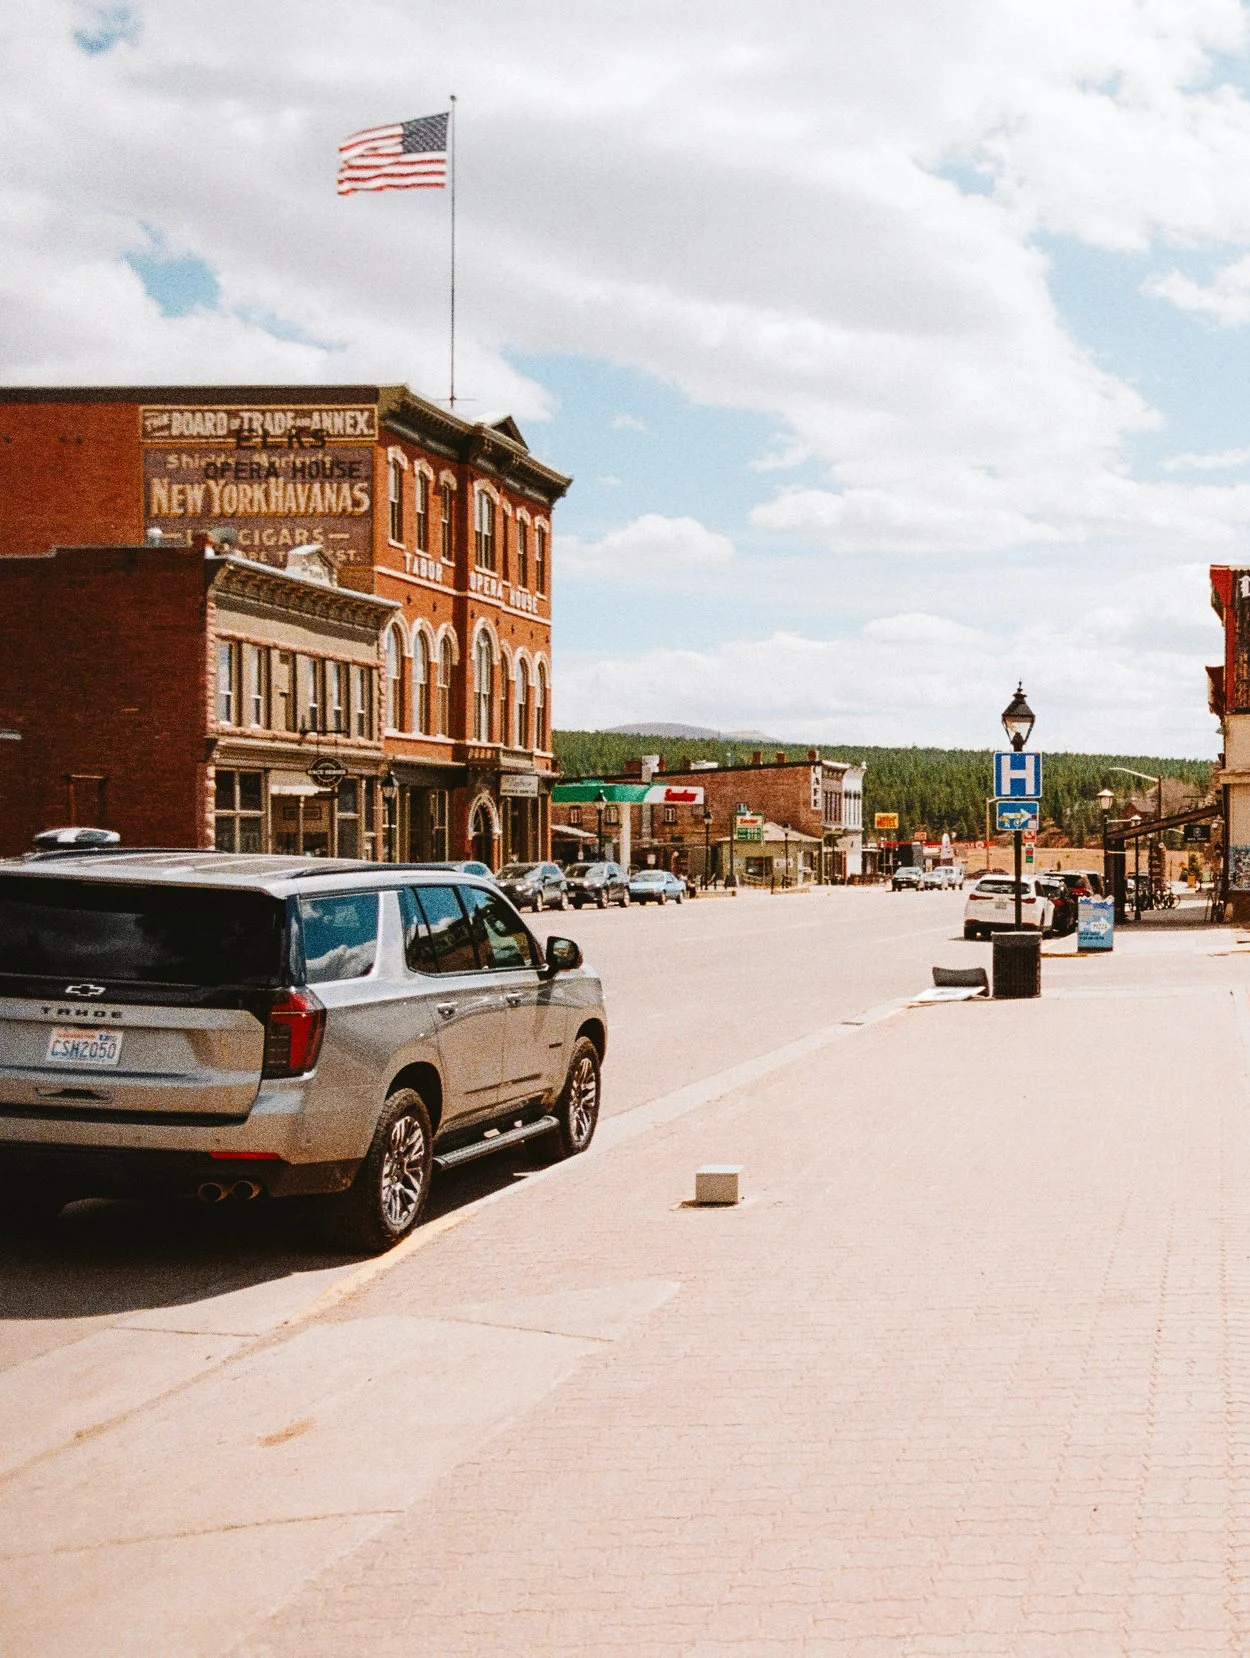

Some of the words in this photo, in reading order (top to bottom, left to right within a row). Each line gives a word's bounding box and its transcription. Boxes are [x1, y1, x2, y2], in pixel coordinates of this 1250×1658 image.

[171, 411, 227, 436] BOARD
[236, 429, 327, 450] ELKS
[204, 460, 279, 480] OPERA
[291, 460, 361, 479] HOUSE
[150, 477, 206, 516] NEW
[206, 477, 268, 516] YORK
[268, 476, 370, 514] HAVANAS
[237, 529, 324, 547] CIGARS
[405, 552, 442, 582] TABOR
[470, 571, 502, 598] OPERA
[510, 589, 538, 614] HOUSE
[1001, 755, 1035, 794] H
[41, 1006, 123, 1018] TAHOE
